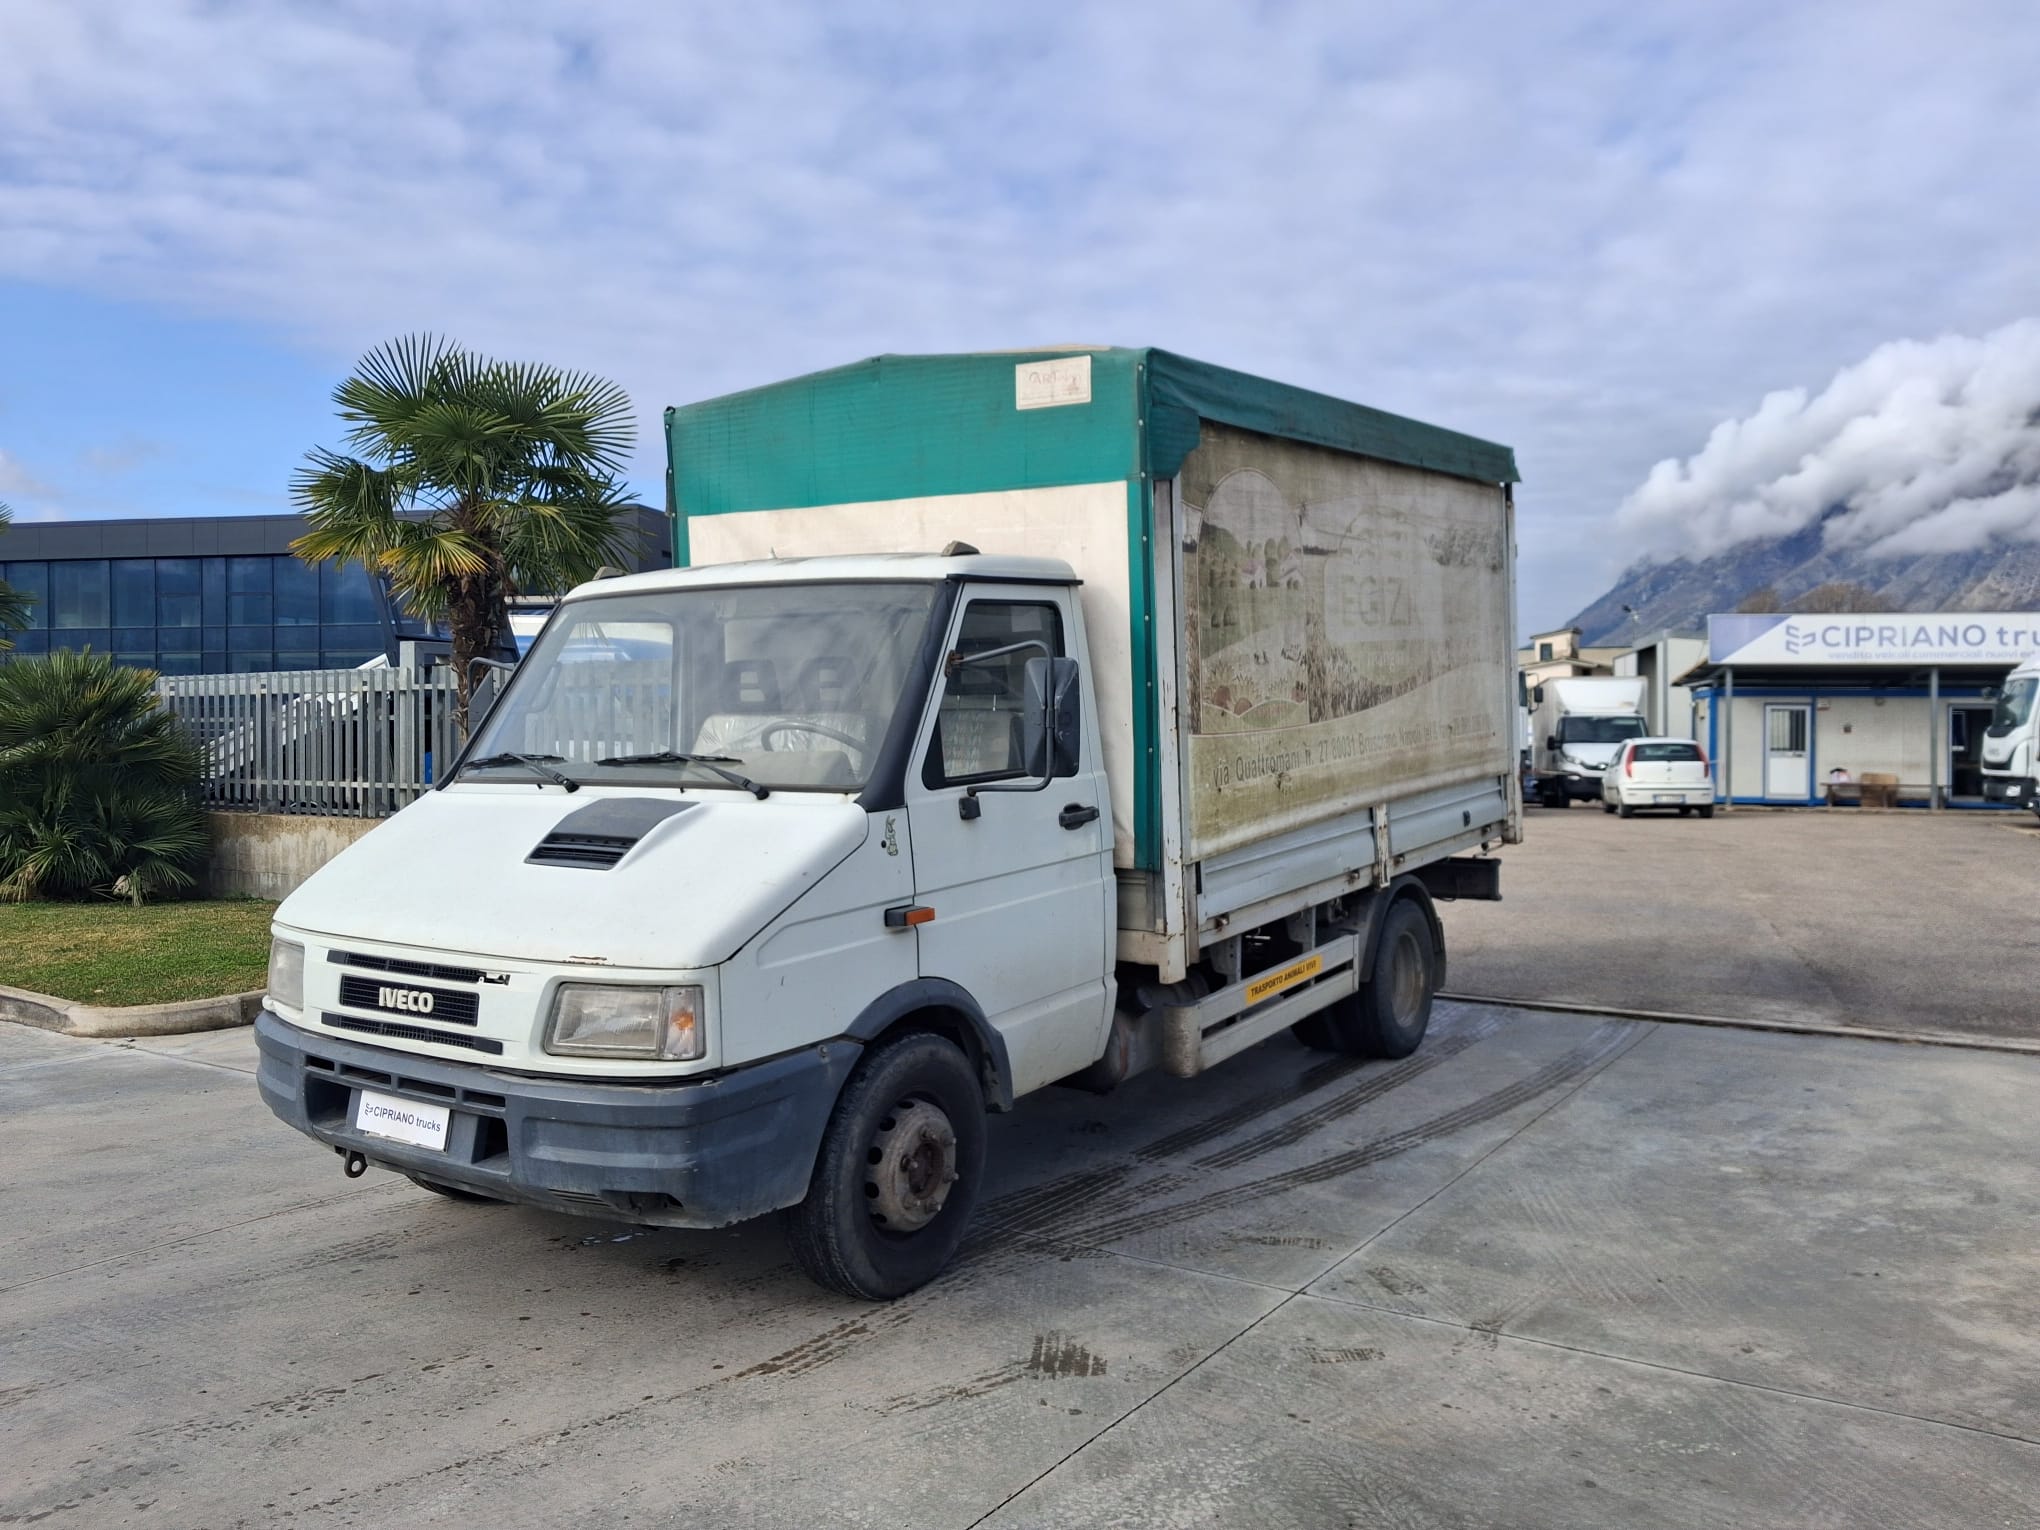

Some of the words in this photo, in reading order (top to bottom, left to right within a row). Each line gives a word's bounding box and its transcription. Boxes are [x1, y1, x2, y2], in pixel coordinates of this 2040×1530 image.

[1821, 624, 1987, 647] CIPRIANO
[1251, 975, 1284, 998] TRASPORTO
[1284, 962, 1305, 981] ANIMALI
[378, 986, 434, 1014] IVECO
[373, 1105, 415, 1126] CIPRIANO
[416, 1115, 441, 1132] trucks
